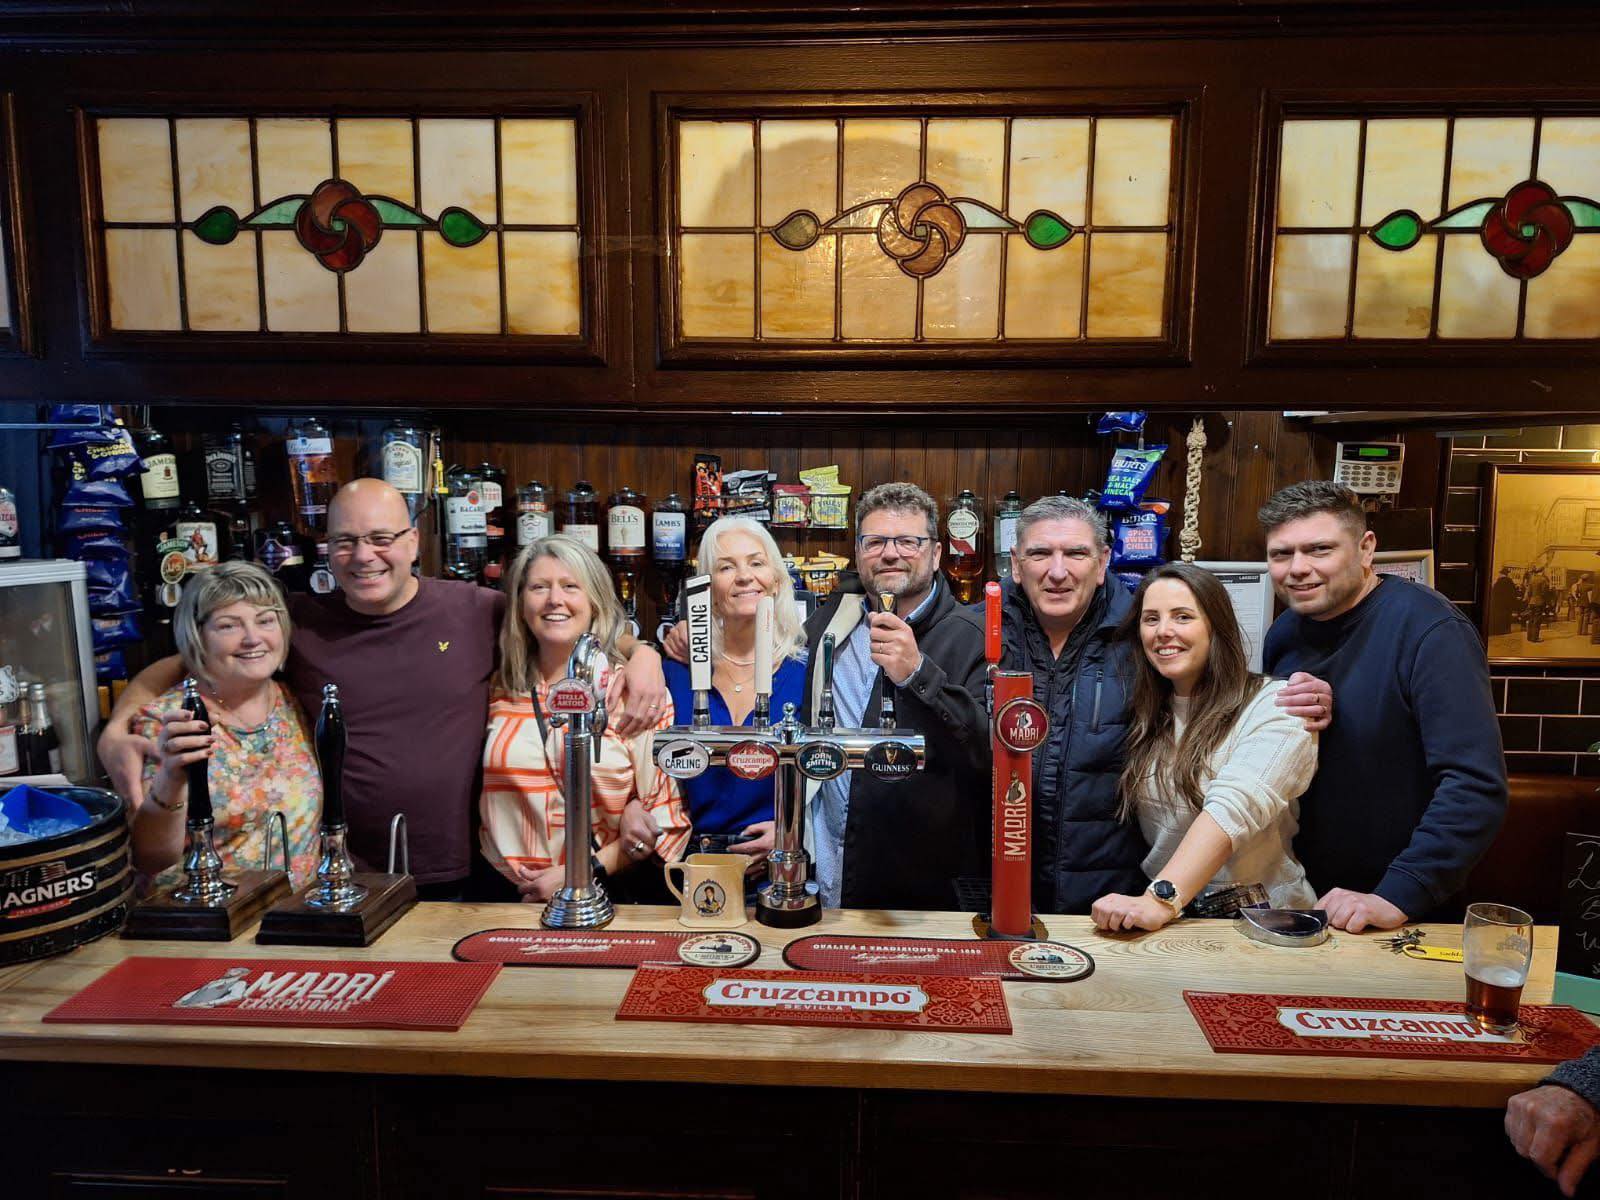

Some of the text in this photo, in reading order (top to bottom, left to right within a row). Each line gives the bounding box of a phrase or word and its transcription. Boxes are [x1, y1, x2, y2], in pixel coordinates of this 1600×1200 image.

[1115, 460, 1148, 470] BURTS
[691, 604, 709, 663] CARLING
[732, 756, 772, 765] Cruzcampo
[810, 753, 832, 761] JOHN
[665, 758, 700, 769] CARLING
[806, 759, 837, 769] SMITH'S
[871, 763, 910, 773] GUINNESS
[0, 871, 94, 912] AGNERS
[721, 982, 911, 1006] Cruzcampo
[1381, 1034, 1446, 1043] SEVILLA
